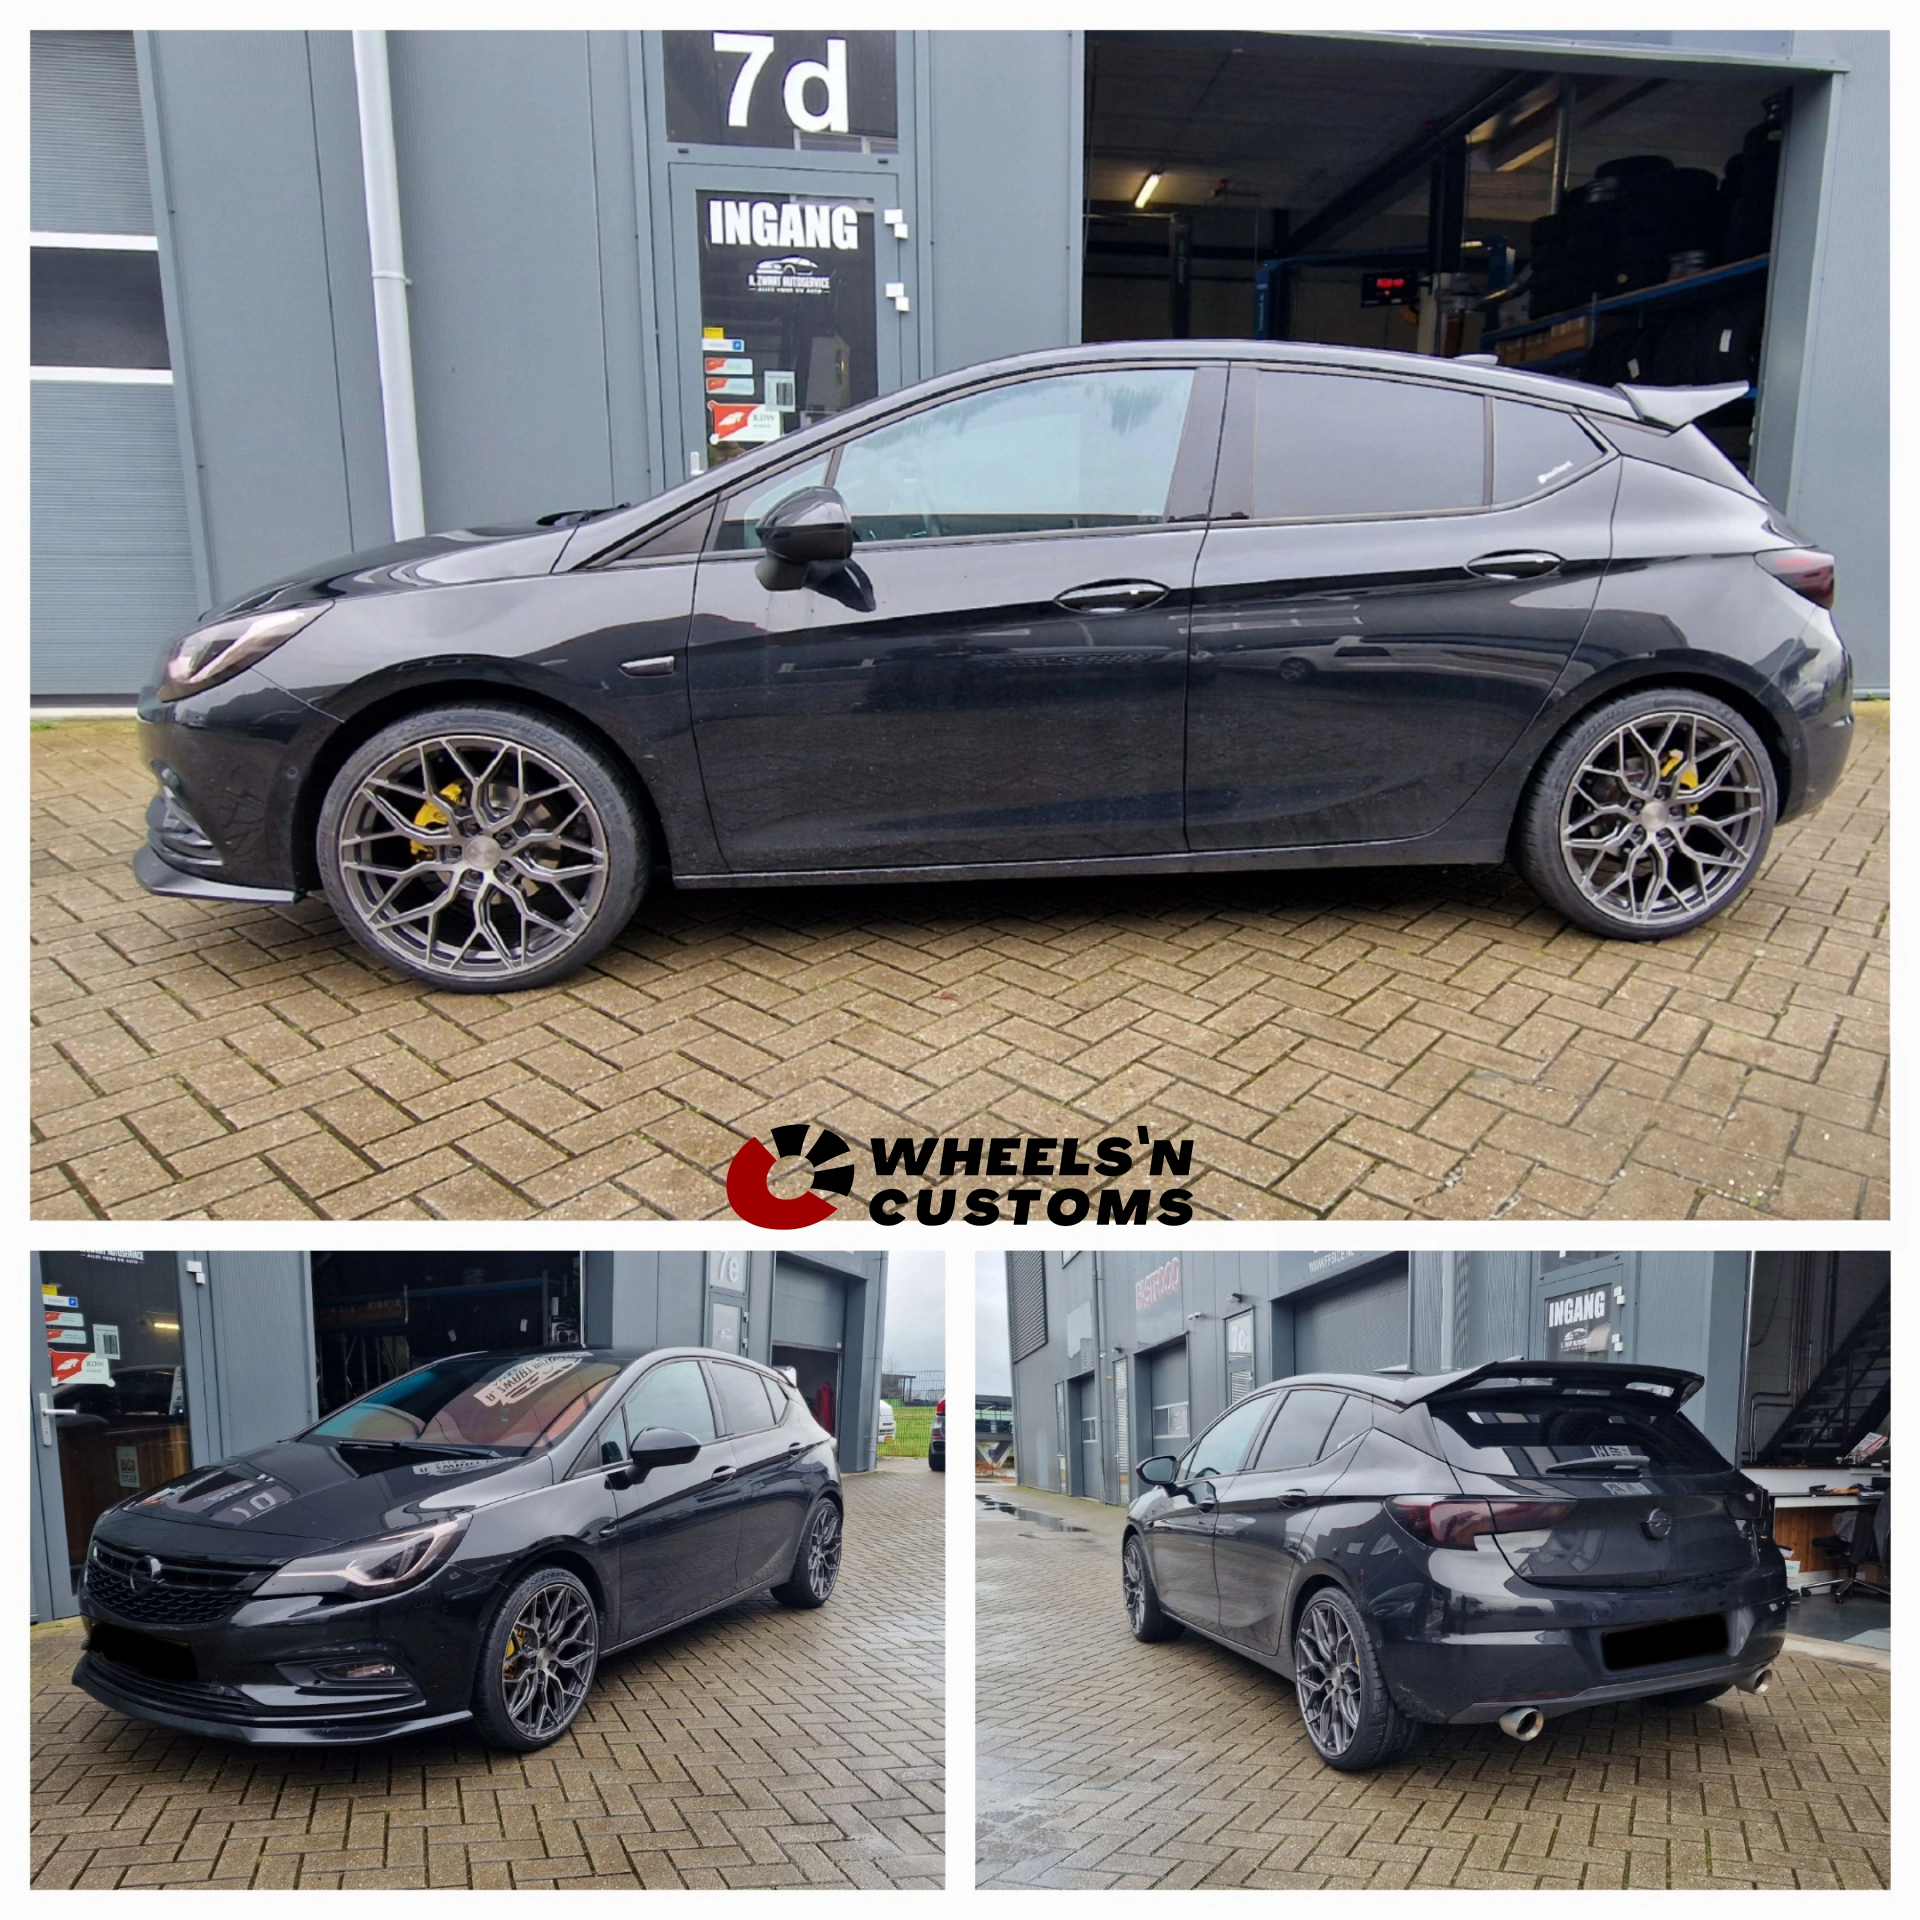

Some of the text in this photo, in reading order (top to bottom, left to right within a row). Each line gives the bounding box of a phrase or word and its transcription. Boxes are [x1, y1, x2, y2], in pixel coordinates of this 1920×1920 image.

[713, 31, 849, 133] 7d
[708, 200, 858, 249] INGANG
[1549, 1291, 1605, 1327] INGANG
